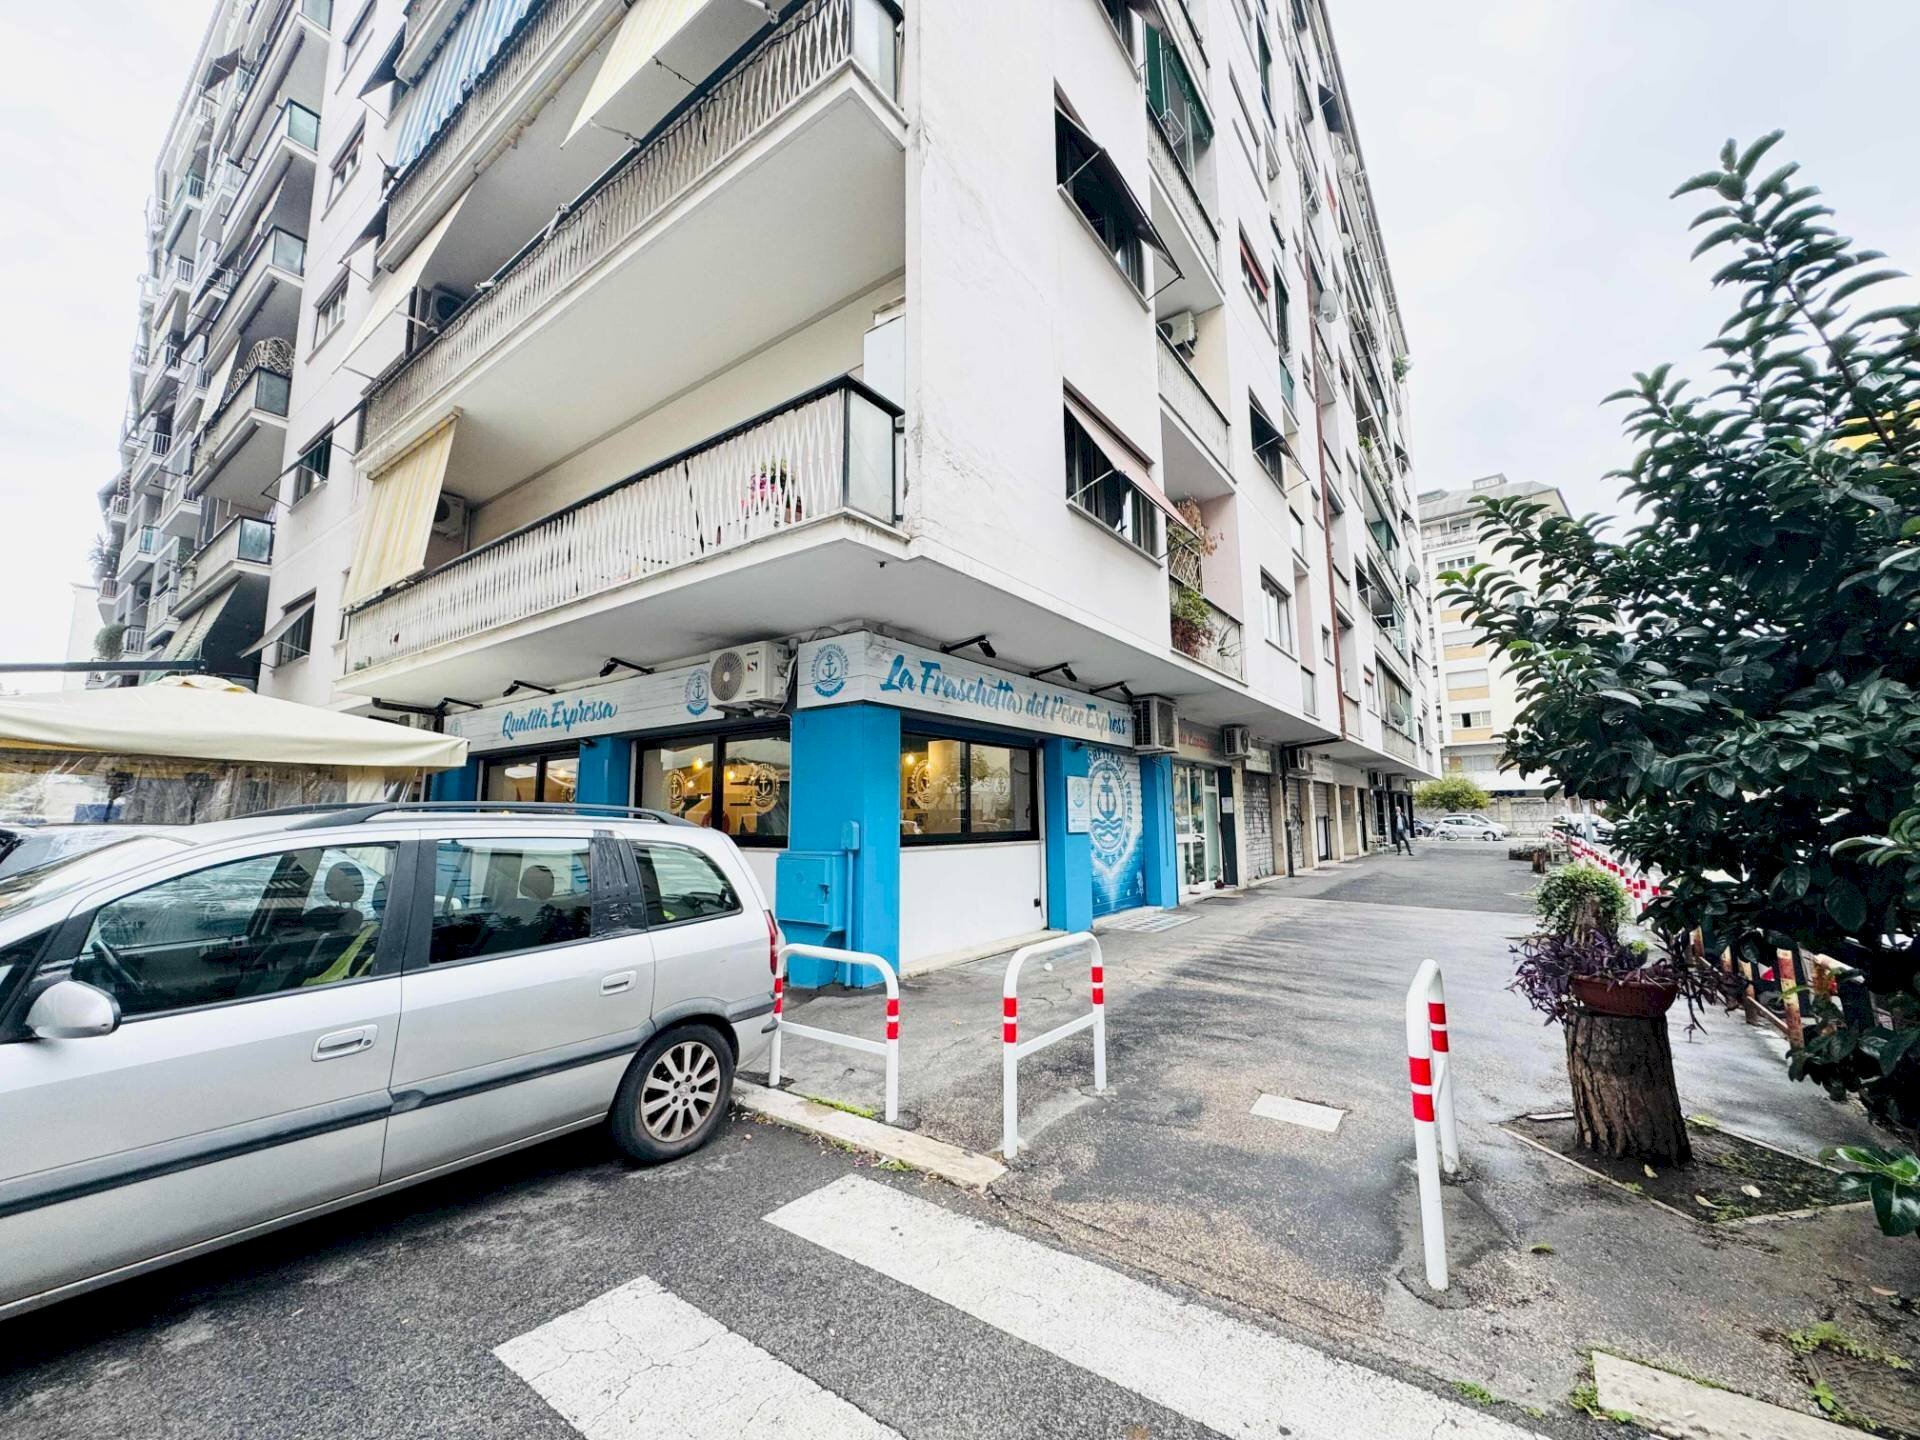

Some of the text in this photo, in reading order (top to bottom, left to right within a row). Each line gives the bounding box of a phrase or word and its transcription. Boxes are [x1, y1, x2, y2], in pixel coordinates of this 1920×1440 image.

[550, 699, 618, 732] Expressa
[880, 654, 916, 692] La
[920, 660, 1022, 714] Fraschetta
[1026, 691, 1049, 719] del
[1050, 695, 1084, 725] Pesce
[1085, 704, 1126, 737] Express
